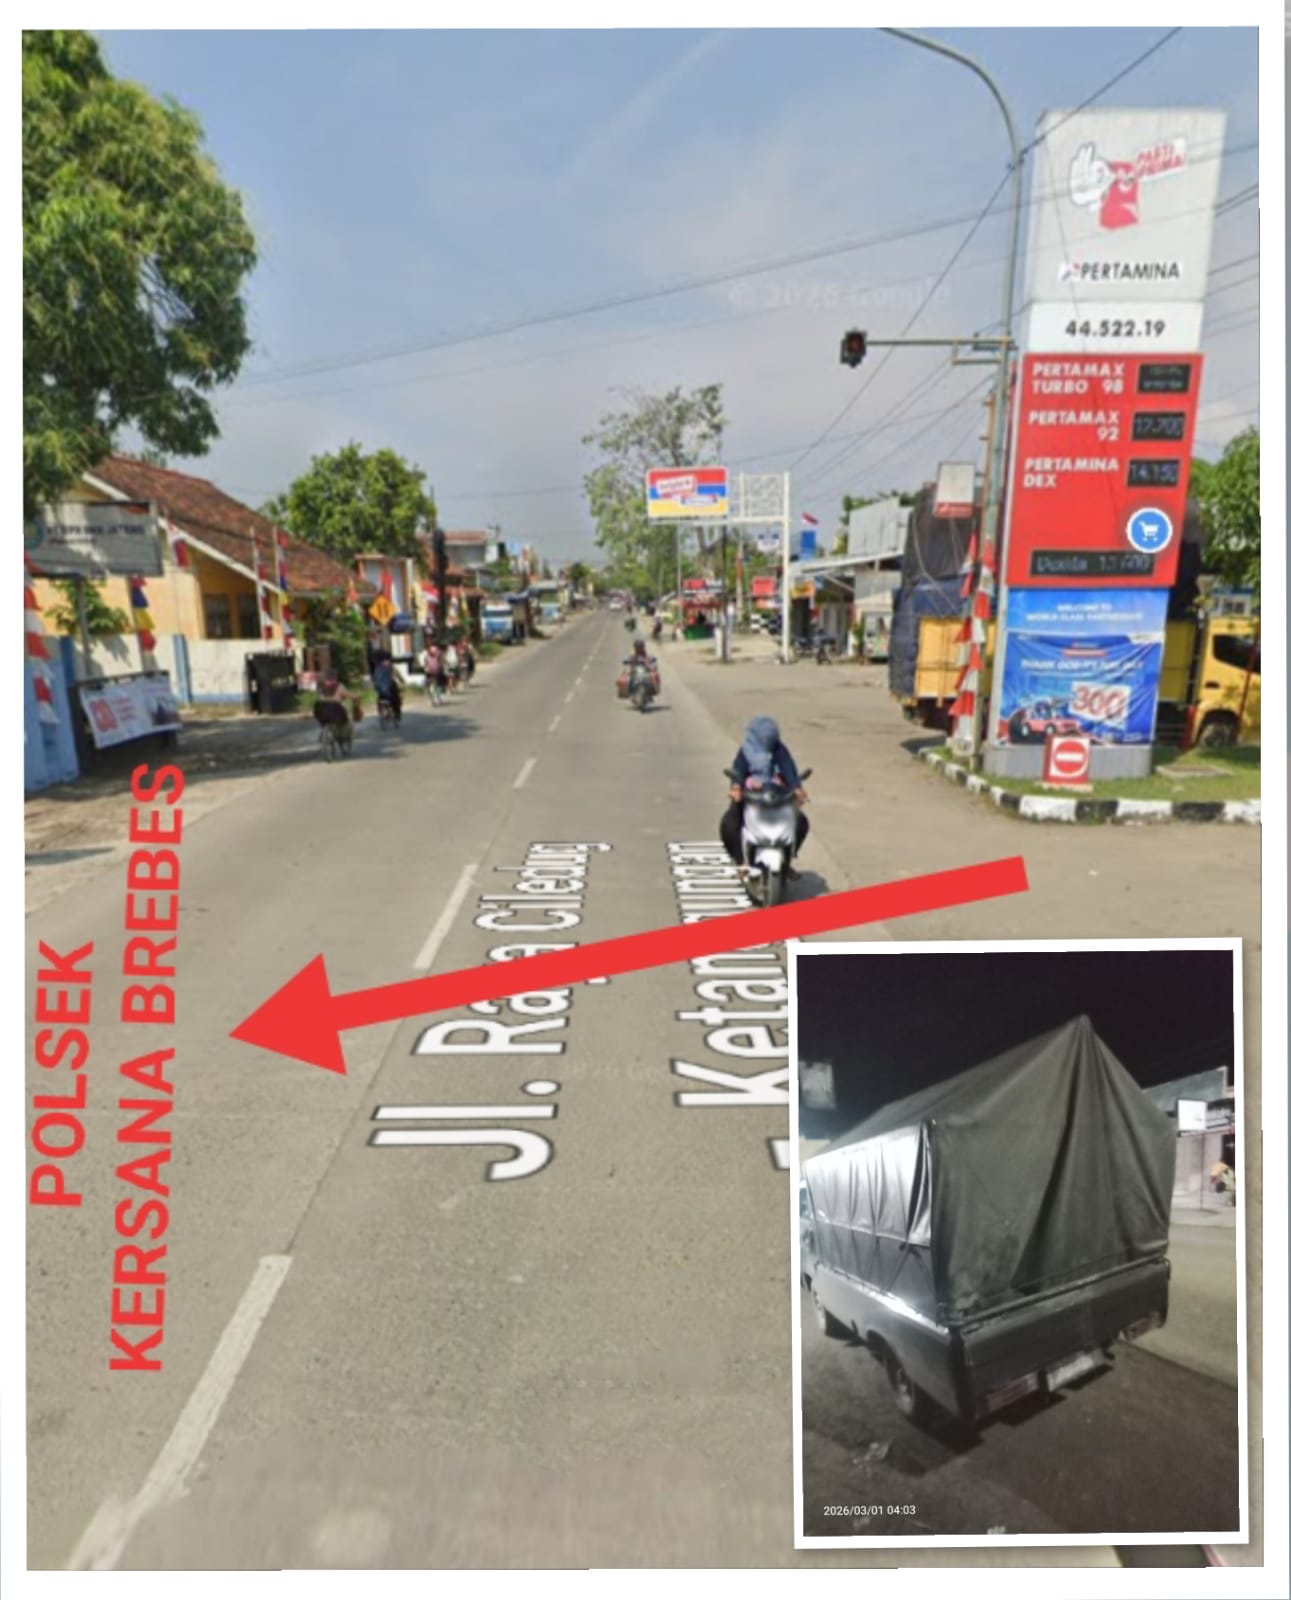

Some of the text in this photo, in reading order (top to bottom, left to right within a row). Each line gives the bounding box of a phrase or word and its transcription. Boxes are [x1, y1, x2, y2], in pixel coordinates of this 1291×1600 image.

[1080, 262, 1179, 280] PERTAMINA
[1065, 321, 1166, 337] 44.522.19
[1032, 363, 1125, 377] PERTAMAX
[1032, 380, 1089, 394] TURBO
[1102, 380, 1124, 394] 98
[1028, 411, 1119, 425] PERTAMAX
[1097, 427, 1120, 441] 92
[1025, 458, 1119, 472] PERTAMINA
[1023, 474, 1056, 487] DEX
